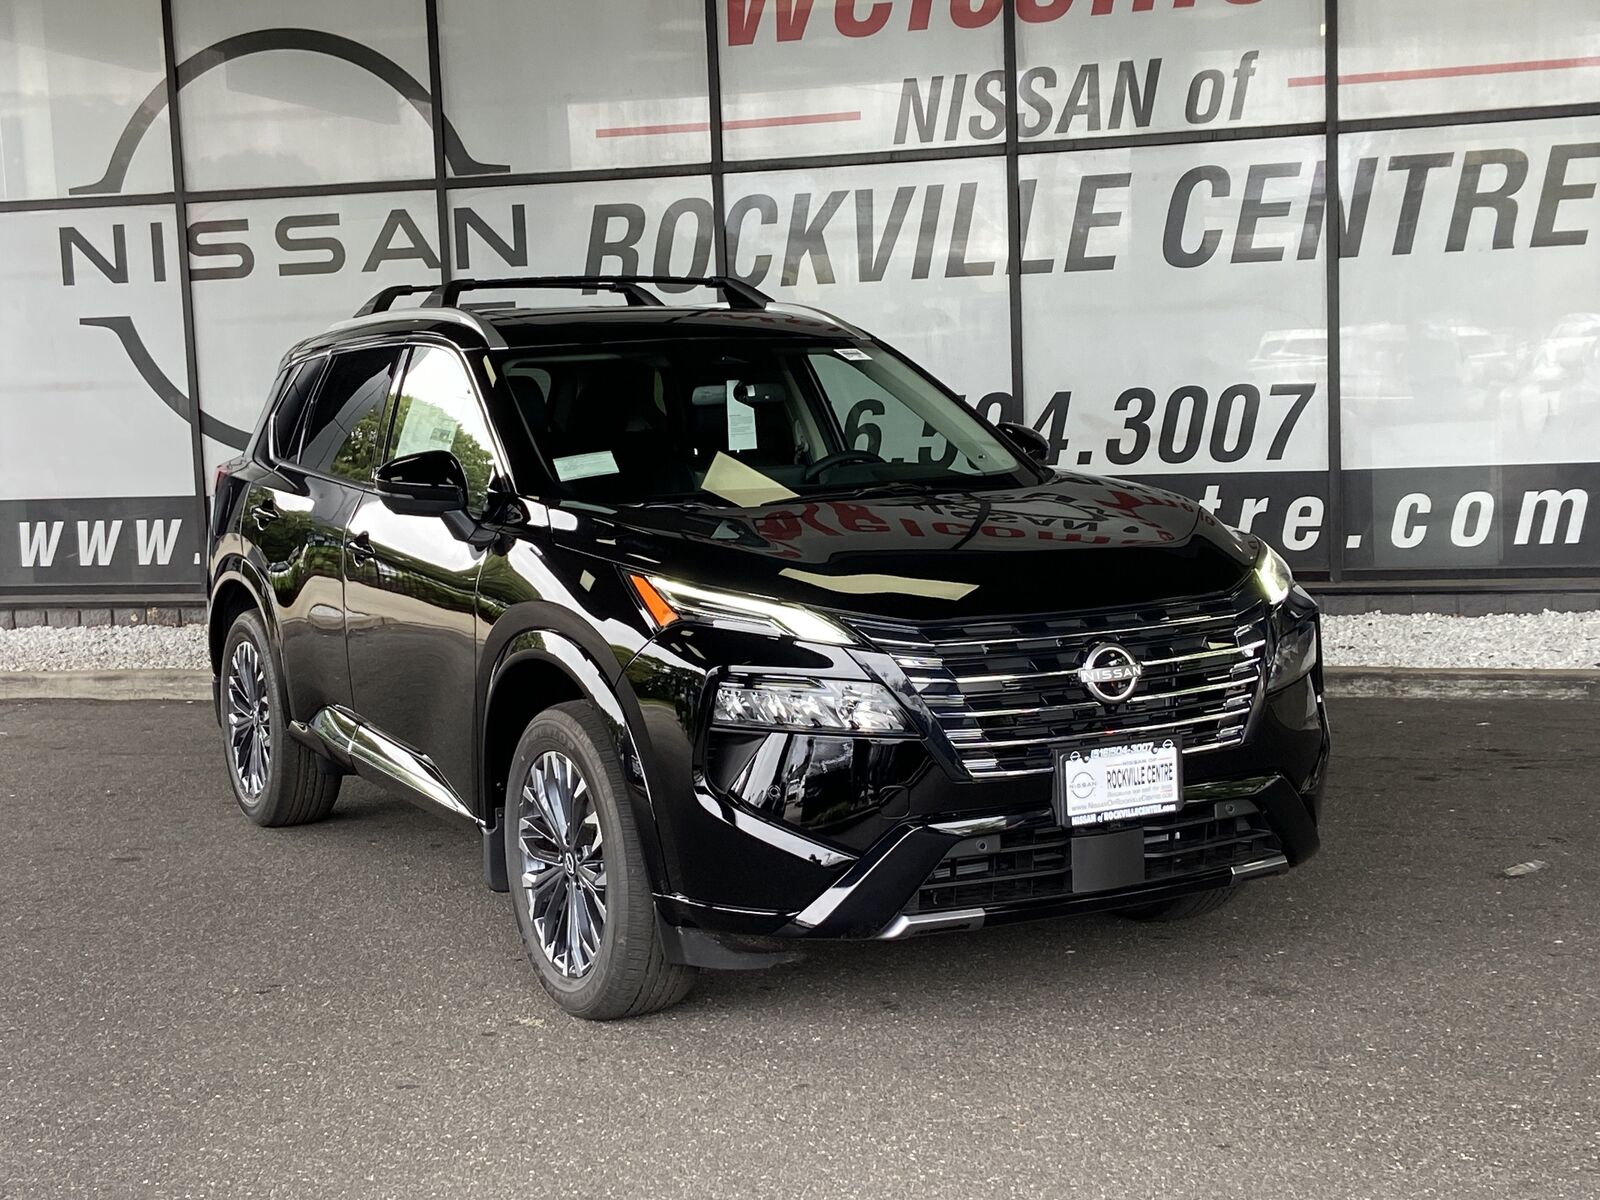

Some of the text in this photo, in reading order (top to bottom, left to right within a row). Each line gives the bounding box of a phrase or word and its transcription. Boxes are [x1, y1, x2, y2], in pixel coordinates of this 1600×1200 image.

[893, 50, 1260, 145] NISSAN of
[581, 142, 1600, 296] ROCKVILLE CENTRE
[59, 204, 528, 286] NISSAN
[1081, 665, 1142, 683] NISSAN
[1069, 781, 1097, 789] NISSAN
[1106, 762, 1173, 789] ROCKVILLE CENTRE
[1071, 813, 1097, 826] NISSAN
